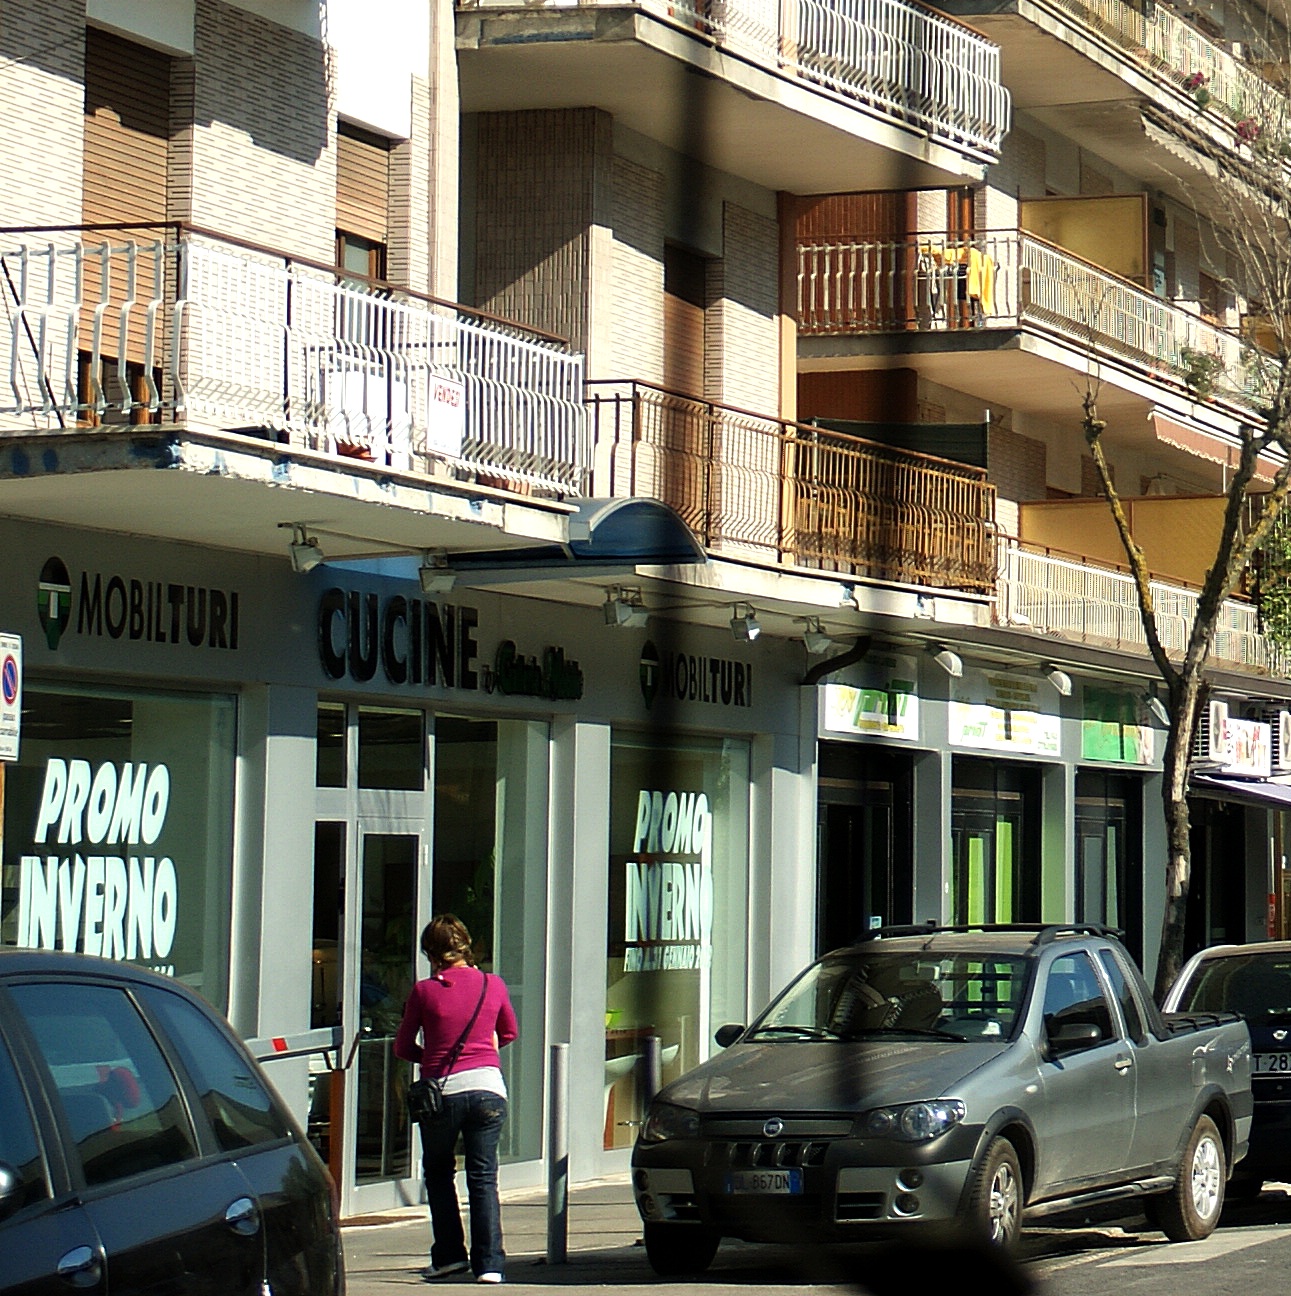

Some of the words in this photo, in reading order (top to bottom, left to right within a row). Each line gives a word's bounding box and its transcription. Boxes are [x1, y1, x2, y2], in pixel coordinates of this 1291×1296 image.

[77, 570, 239, 650] MOBILTURI
[317, 586, 479, 691] CUCINE
[34, 758, 170, 845] PROMO
[633, 790, 709, 854] PROMO
[17, 854, 178, 961] INVERNO
[625, 862, 713, 942] INVERNO
